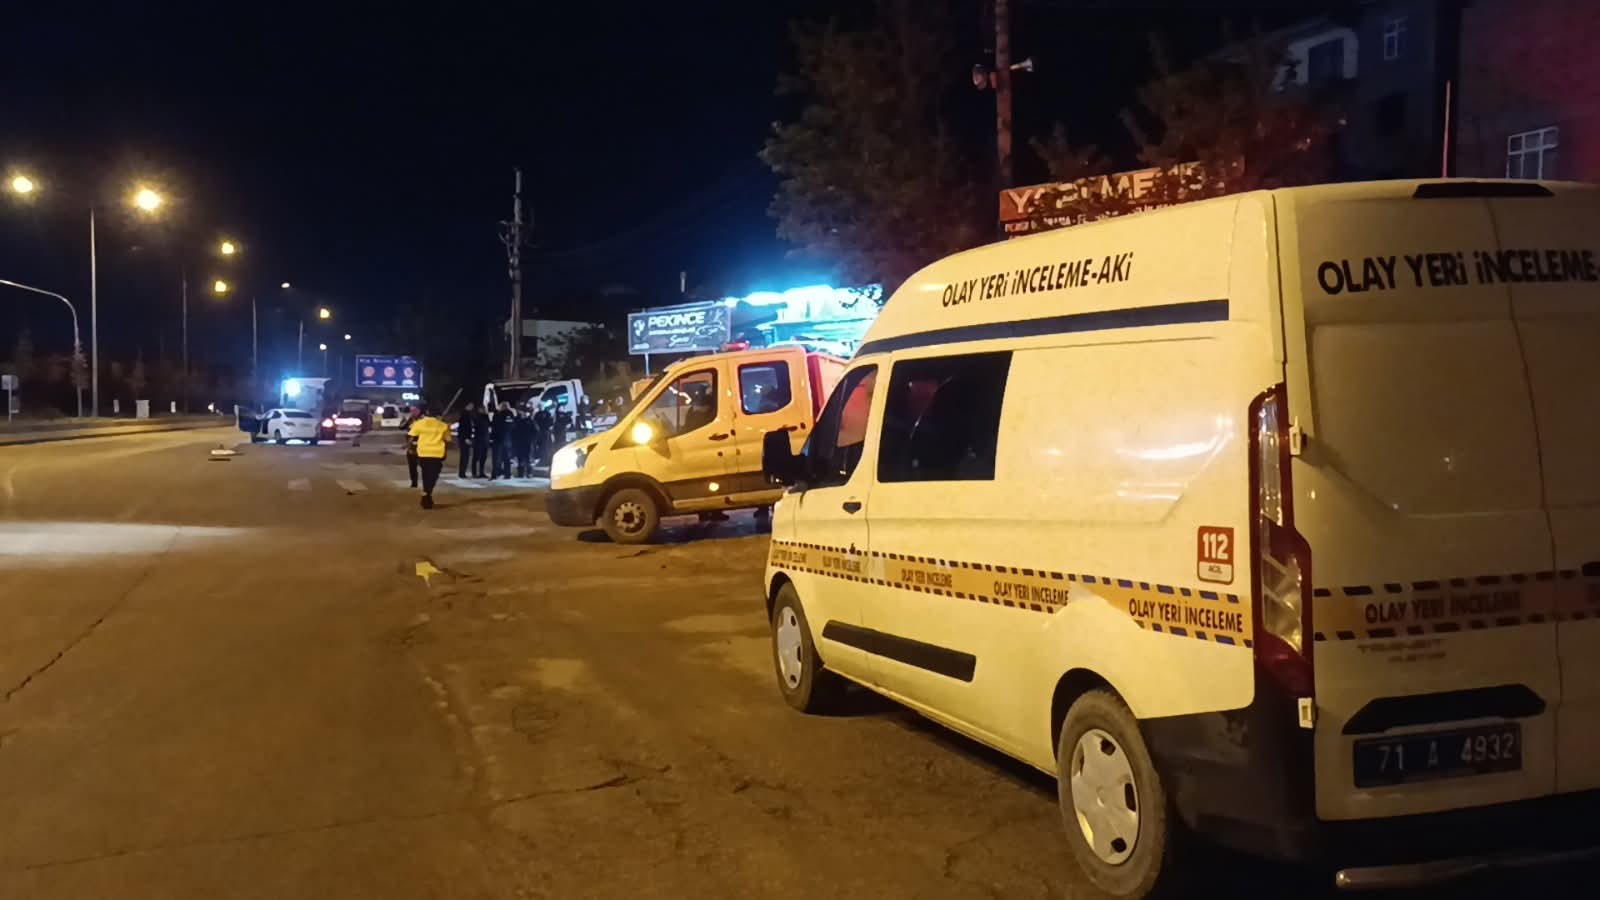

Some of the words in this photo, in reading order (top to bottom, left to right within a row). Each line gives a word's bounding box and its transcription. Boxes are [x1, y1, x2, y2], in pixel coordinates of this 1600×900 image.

[1317, 255, 1396, 295] OLAY
[942, 278, 977, 307] OLAY
[1202, 532, 1229, 560] 112
[993, 581, 1012, 597] OLAY
[1129, 598, 1155, 620] OLAY
[1365, 600, 1407, 624] OLAY
[1377, 744, 1404, 773] 71
[1427, 741, 1439, 767] A
[1460, 733, 1514, 761] 4932
